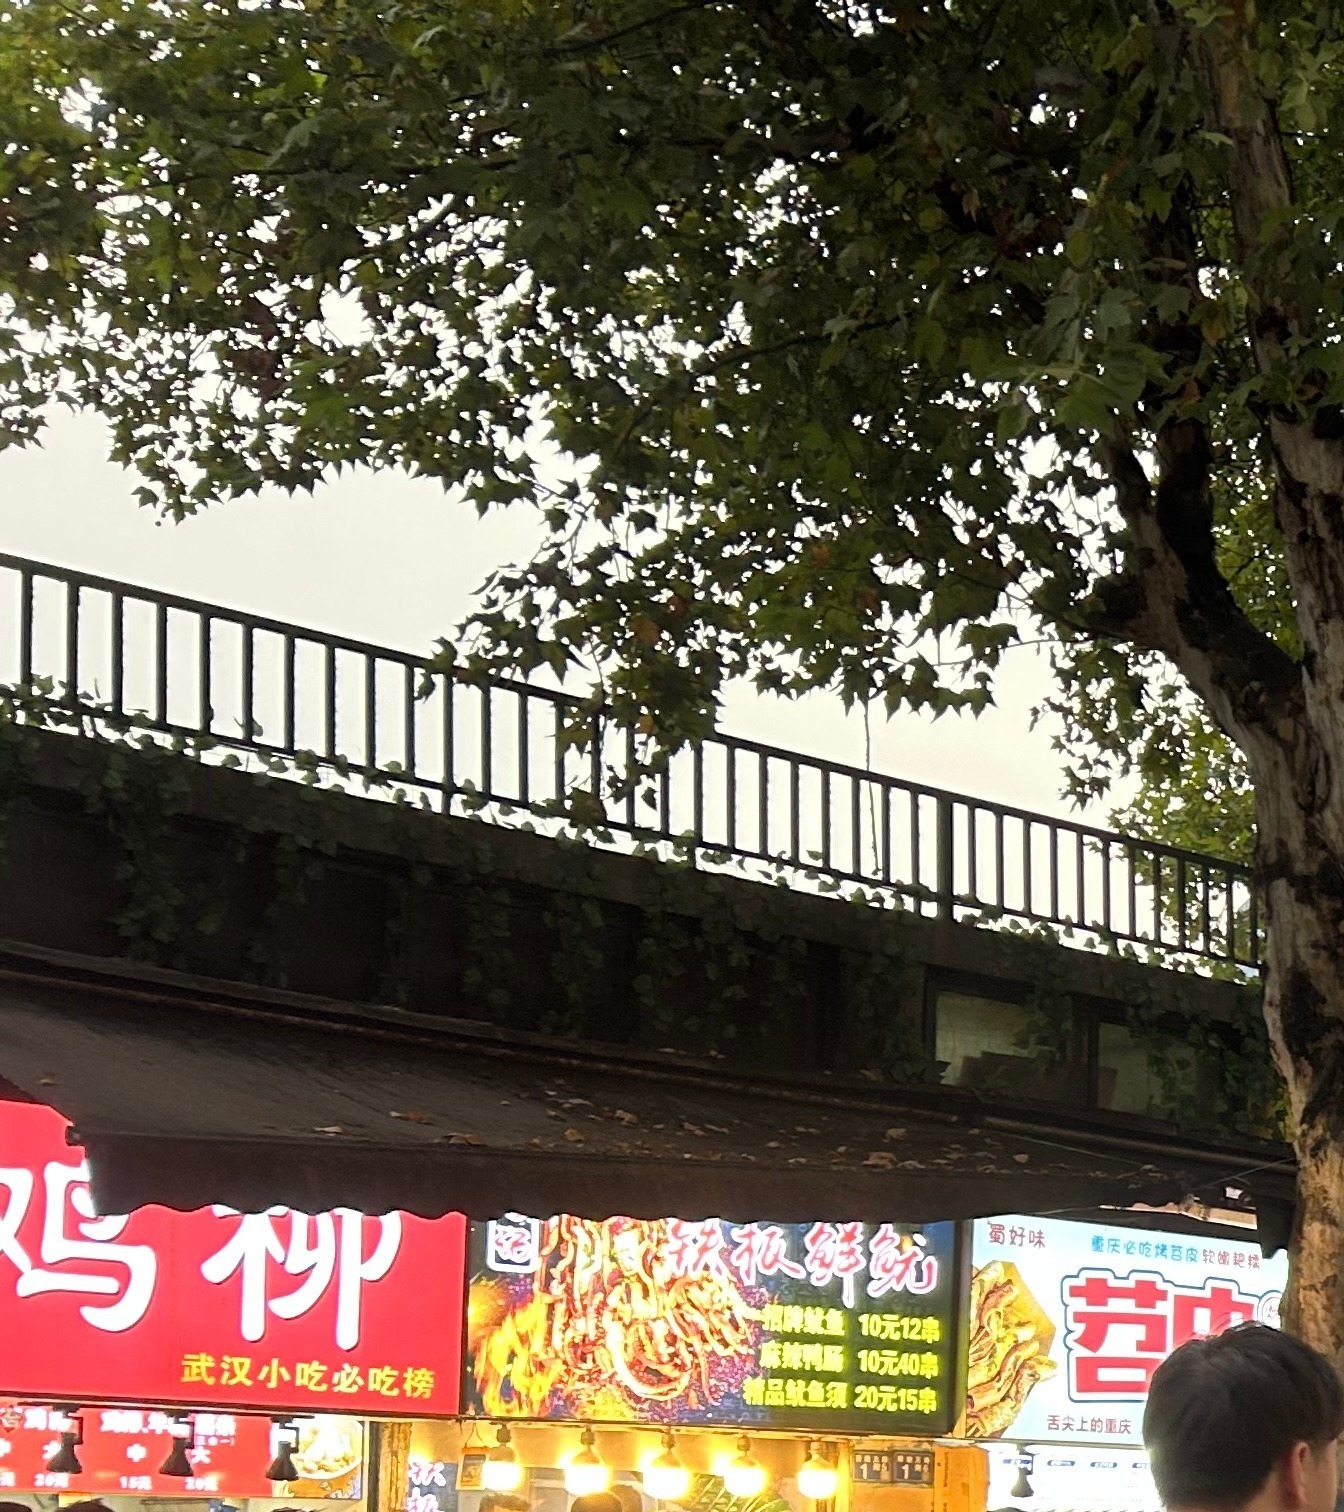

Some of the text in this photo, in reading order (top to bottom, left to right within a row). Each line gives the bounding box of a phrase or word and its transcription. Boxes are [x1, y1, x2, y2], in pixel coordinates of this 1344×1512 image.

[987, 1222, 1046, 1249] 蜀好味
[1091, 1235, 1199, 1264] 重庆必吃烤苕皮
[857, 1312, 941, 1345] 10元12串
[759, 1339, 940, 1380] 麻辣鸭肠 10元40串
[180, 1352, 435, 1399] 武汉小吃必吃榜
[853, 1384, 938, 1414] 20元15串
[1046, 1414, 1132, 1435] 舌尖上的重庆
